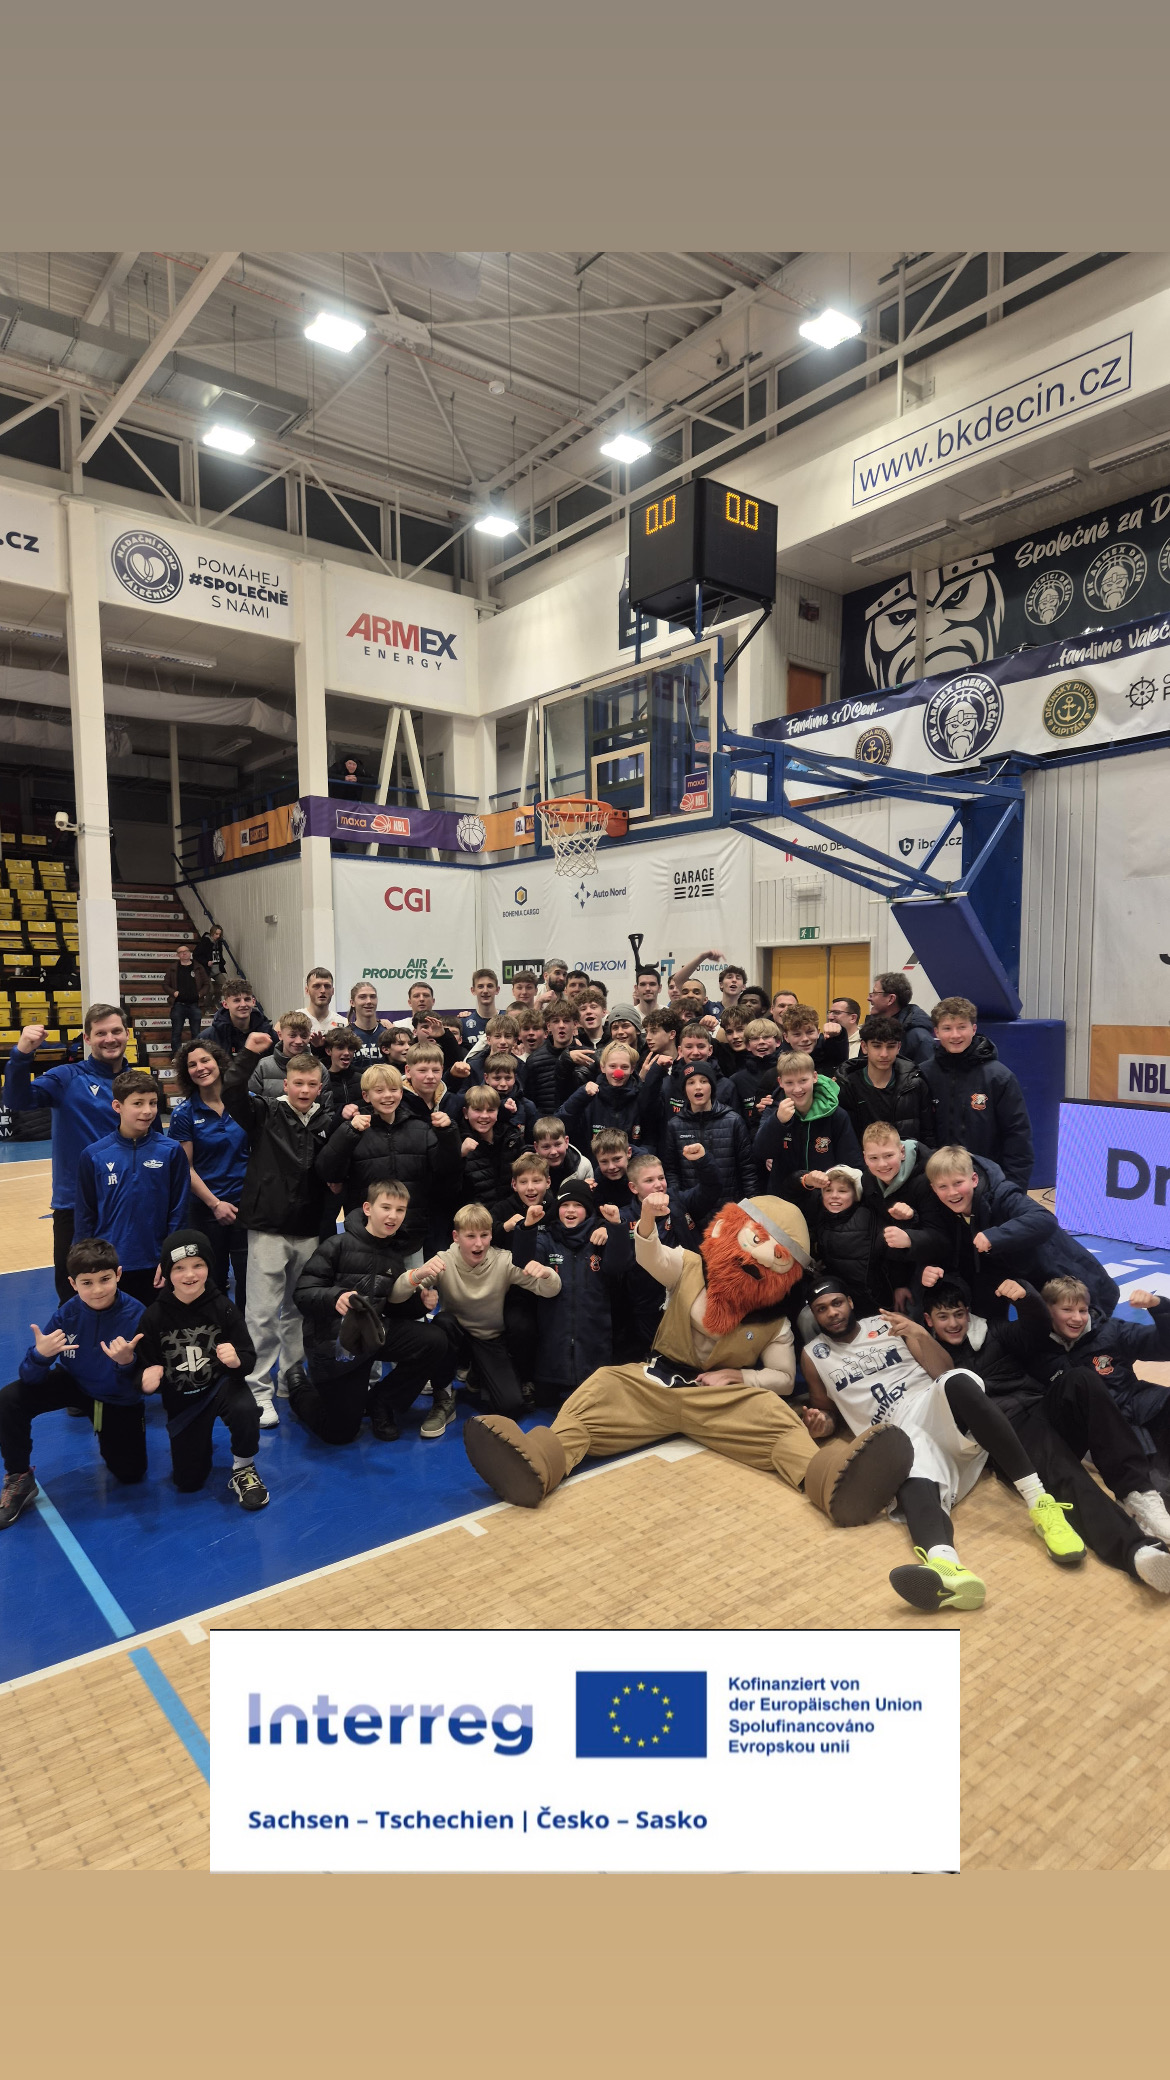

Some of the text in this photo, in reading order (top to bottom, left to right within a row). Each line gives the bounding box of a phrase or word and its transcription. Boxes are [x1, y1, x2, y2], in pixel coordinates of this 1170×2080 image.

[859, 356, 1122, 492] www.bkdecin.cz
[645, 494, 677, 535] 0.0
[725, 491, 760, 531] 0.0
[1117, 508, 1144, 533] za
[117, 535, 178, 570] NADAČNÍ FOND
[1090, 546, 1126, 576] ARMEX
[198, 556, 279, 587] POMÁHEJ
[189, 572, 289, 606] #SPOLEČNĚ
[211, 595, 269, 618] S NÁMI
[346, 613, 458, 660] ARMEX
[364, 646, 442, 671] ENERGY
[955, 678, 991, 694] ENERGY
[1073, 683, 1095, 709] PIVOVAR
[930, 686, 954, 724] ARMEX
[930, 727, 940, 743] BK
[340, 815, 406, 832] maxa NBL
[674, 868, 715, 884] GARAGE
[384, 886, 431, 913] CGI
[593, 887, 627, 898] Auto Nord
[688, 885, 700, 898] 22
[523, 908, 540, 916] CARGO
[362, 968, 428, 979] PRODUCTS
[407, 958, 428, 969] AIR
[574, 960, 627, 972] OMEXOM
[1129, 1063, 1170, 1094] NBL
[828, 1345, 903, 1392] DĚČÍN
